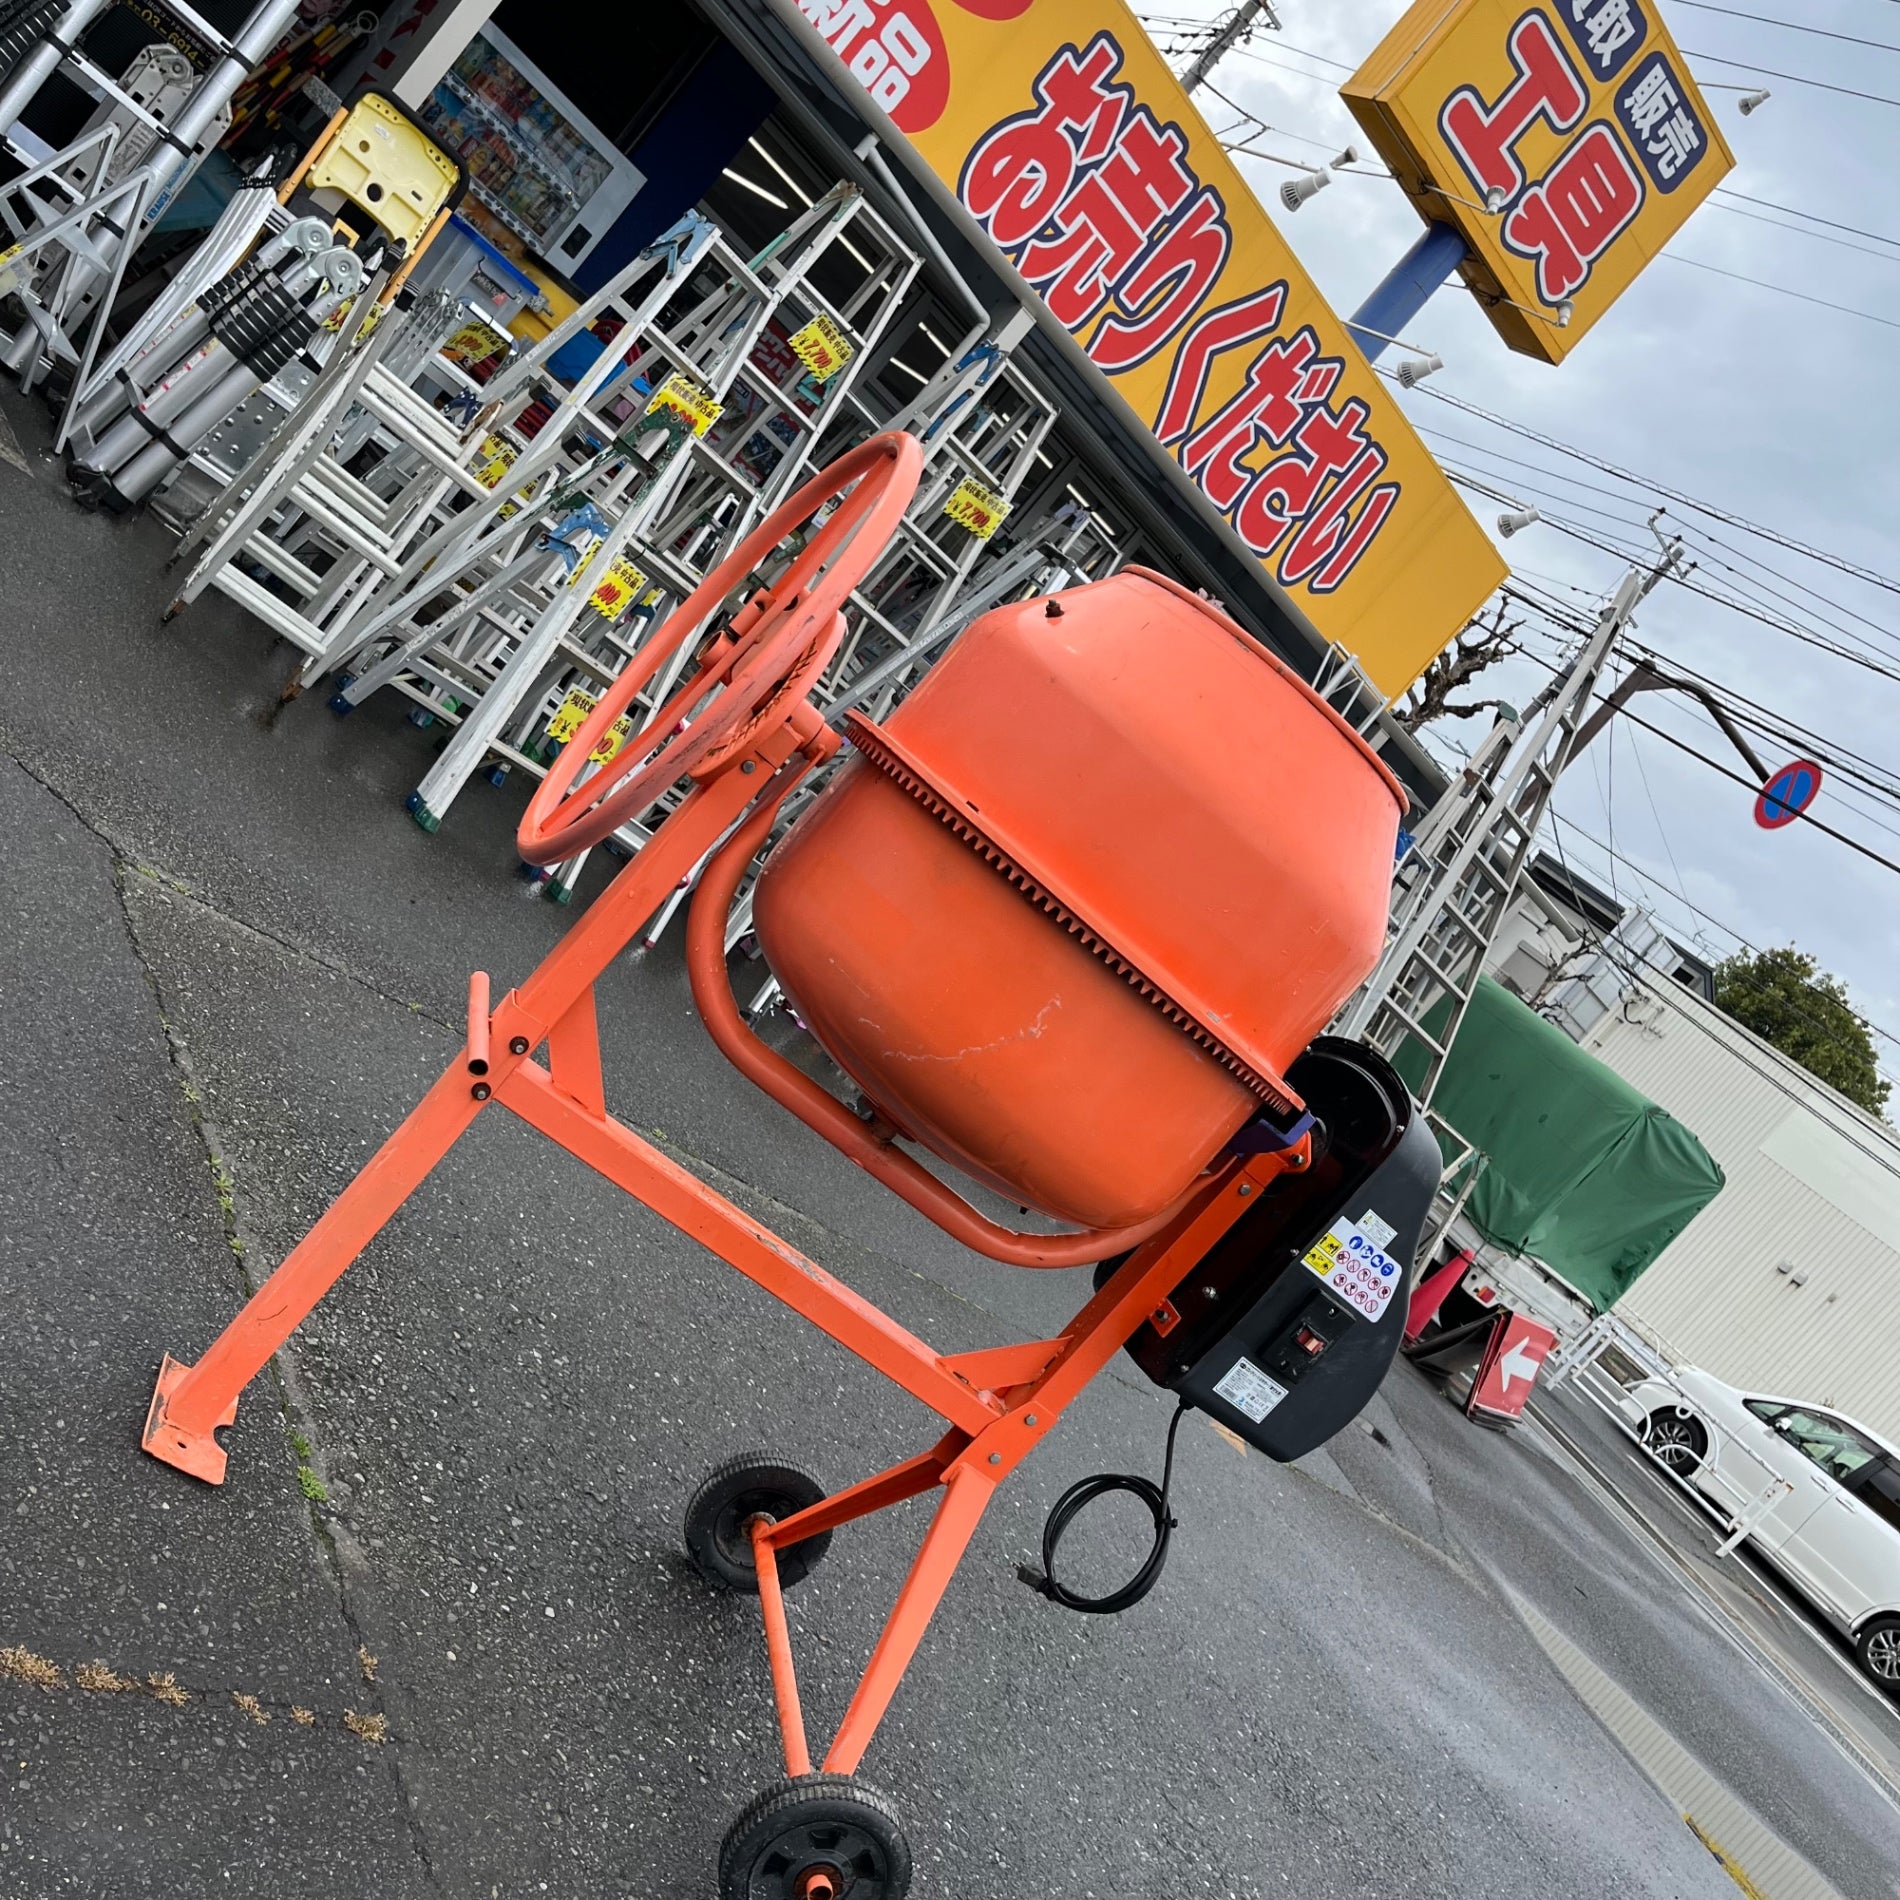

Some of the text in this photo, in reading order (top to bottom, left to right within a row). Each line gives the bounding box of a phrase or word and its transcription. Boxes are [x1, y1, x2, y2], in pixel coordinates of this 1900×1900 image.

[1624, 62, 1700, 180] 販売
[1438, 8, 1645, 306] 工具
[957, 29, 1401, 593] お売りください
[832, 340, 848, 359] 中古品
[693, 398, 716, 419] 中古品
[985, 497, 1006, 514] 中古品
[618, 567, 639, 589] 中古品
